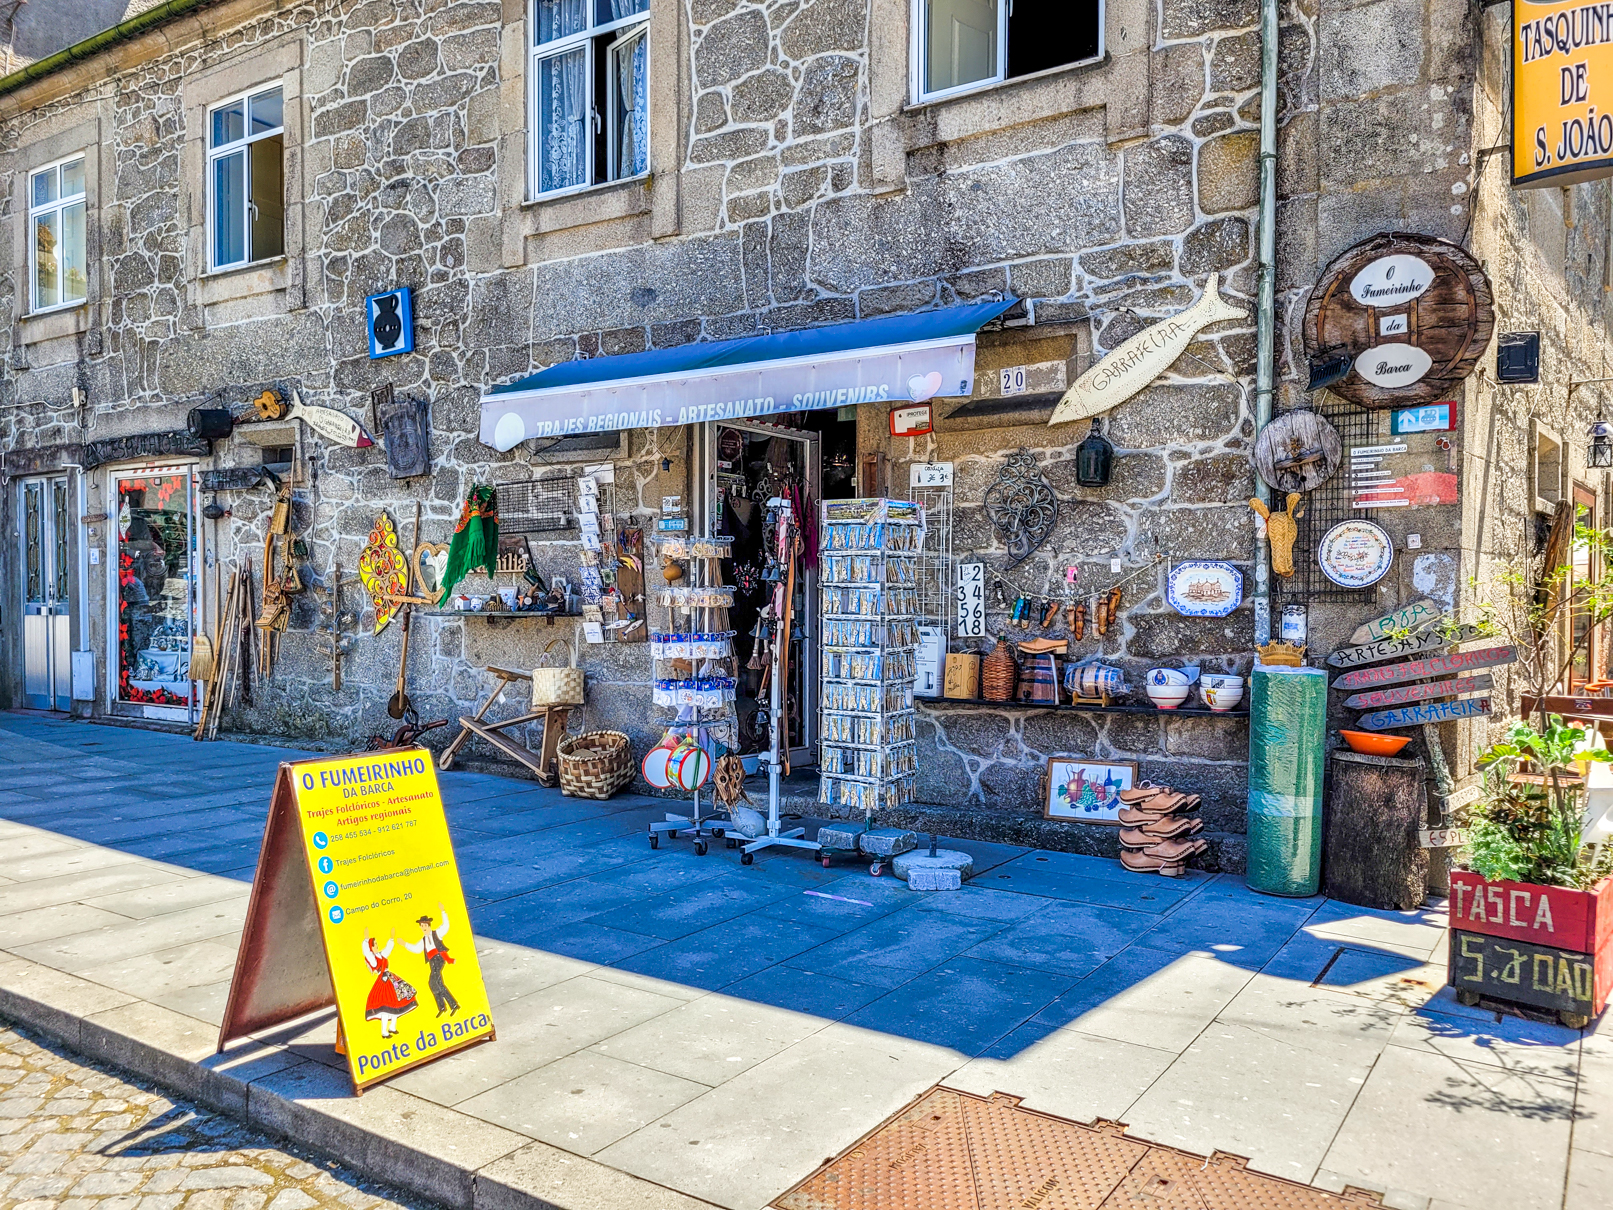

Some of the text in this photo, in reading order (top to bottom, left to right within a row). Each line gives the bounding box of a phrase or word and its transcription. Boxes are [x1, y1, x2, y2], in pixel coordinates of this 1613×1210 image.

[1560, 62, 1588, 106] DE
[1535, 107, 1613, 168] S. JOÃO
[1385, 265, 1396, 281] O
[1361, 278, 1424, 299] Fumeirinho
[1386, 318, 1404, 332] da
[1004, 371, 1023, 389] 20
[1375, 361, 1413, 376] Barca
[536, 416, 584, 437] TRAJES
[587, 408, 662, 431] REGIONAIS
[678, 396, 775, 426] ARTESANATO
[792, 383, 889, 410] SOUVENIRS
[1367, 604, 1434, 640] LOJA
[1358, 677, 1475, 708] SOUVENIRES
[1371, 699, 1490, 727] GARRAFEIRA
[302, 757, 425, 791] O FUMEIRINHO
[342, 781, 395, 799] DA BARCA
[306, 807, 334, 819] Trajes
[336, 799, 381, 814] Folclóricos
[387, 791, 434, 806] Artesanato
[336, 805, 412, 827] Artigos regionais
[330, 832, 343, 842] 258
[345, 831, 358, 839] 455
[359, 828, 372, 837] 534
[377, 824, 390, 834] 912
[391, 822, 404, 831] 621
[1429, 830, 1465, 847] ESPL
[336, 848, 395, 867] Trajes Folclóricos
[340, 859, 450, 891] fumeirinhodabarca@hotmail.com
[345, 904, 370, 916] Campo
[371, 901, 380, 909] do
[404, 892, 413, 900] 20
[1453, 880, 1554, 932] TASCA
[358, 1013, 487, 1075] Ponte da Barca
